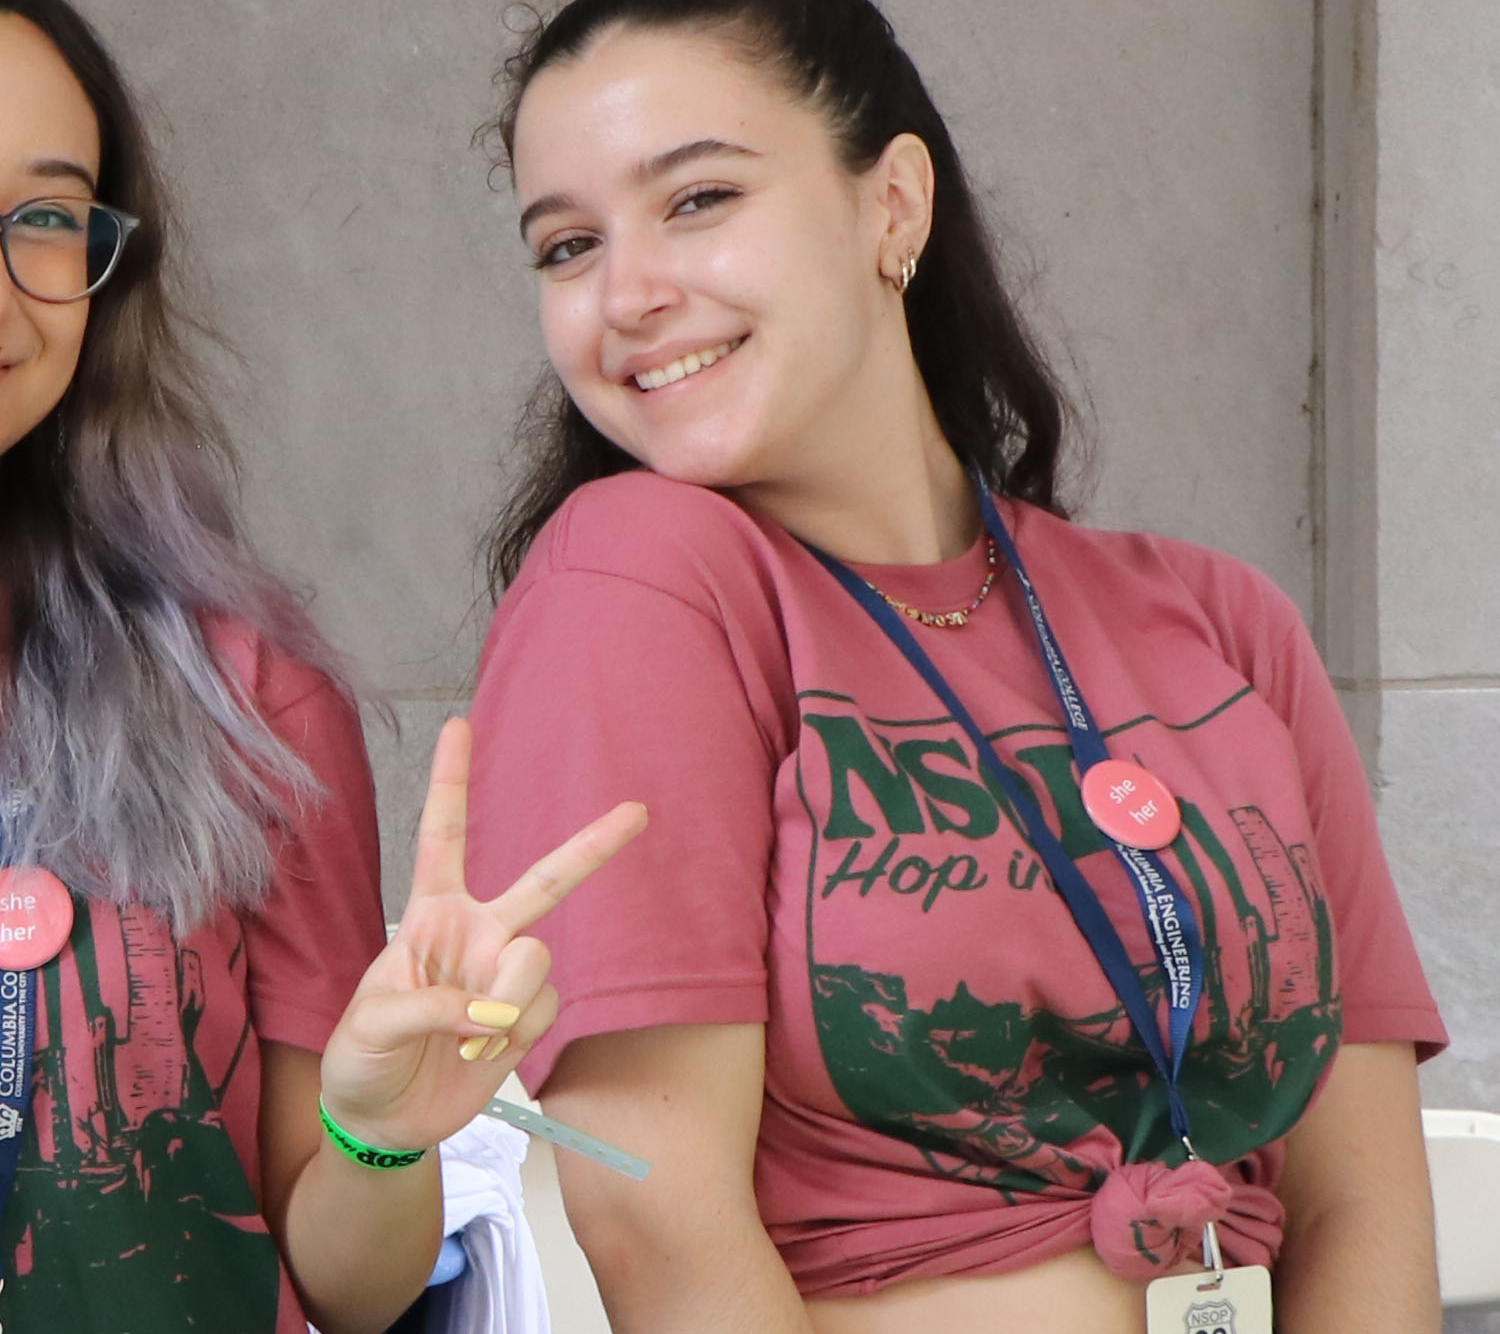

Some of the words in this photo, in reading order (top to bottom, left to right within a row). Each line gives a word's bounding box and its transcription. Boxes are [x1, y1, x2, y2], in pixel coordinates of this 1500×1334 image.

[1055, 665, 1090, 734] COLLEGE
[1109, 776, 1137, 805] she
[1129, 797, 1160, 825] her
[821, 837, 988, 913] Hop
[0, 892, 37, 911] she
[0, 922, 37, 943] her
[1126, 844, 1166, 893] OLUMBIA
[1157, 893, 1192, 1010] ENGINEERING
[1190, 1309, 1229, 1326] NSOP
